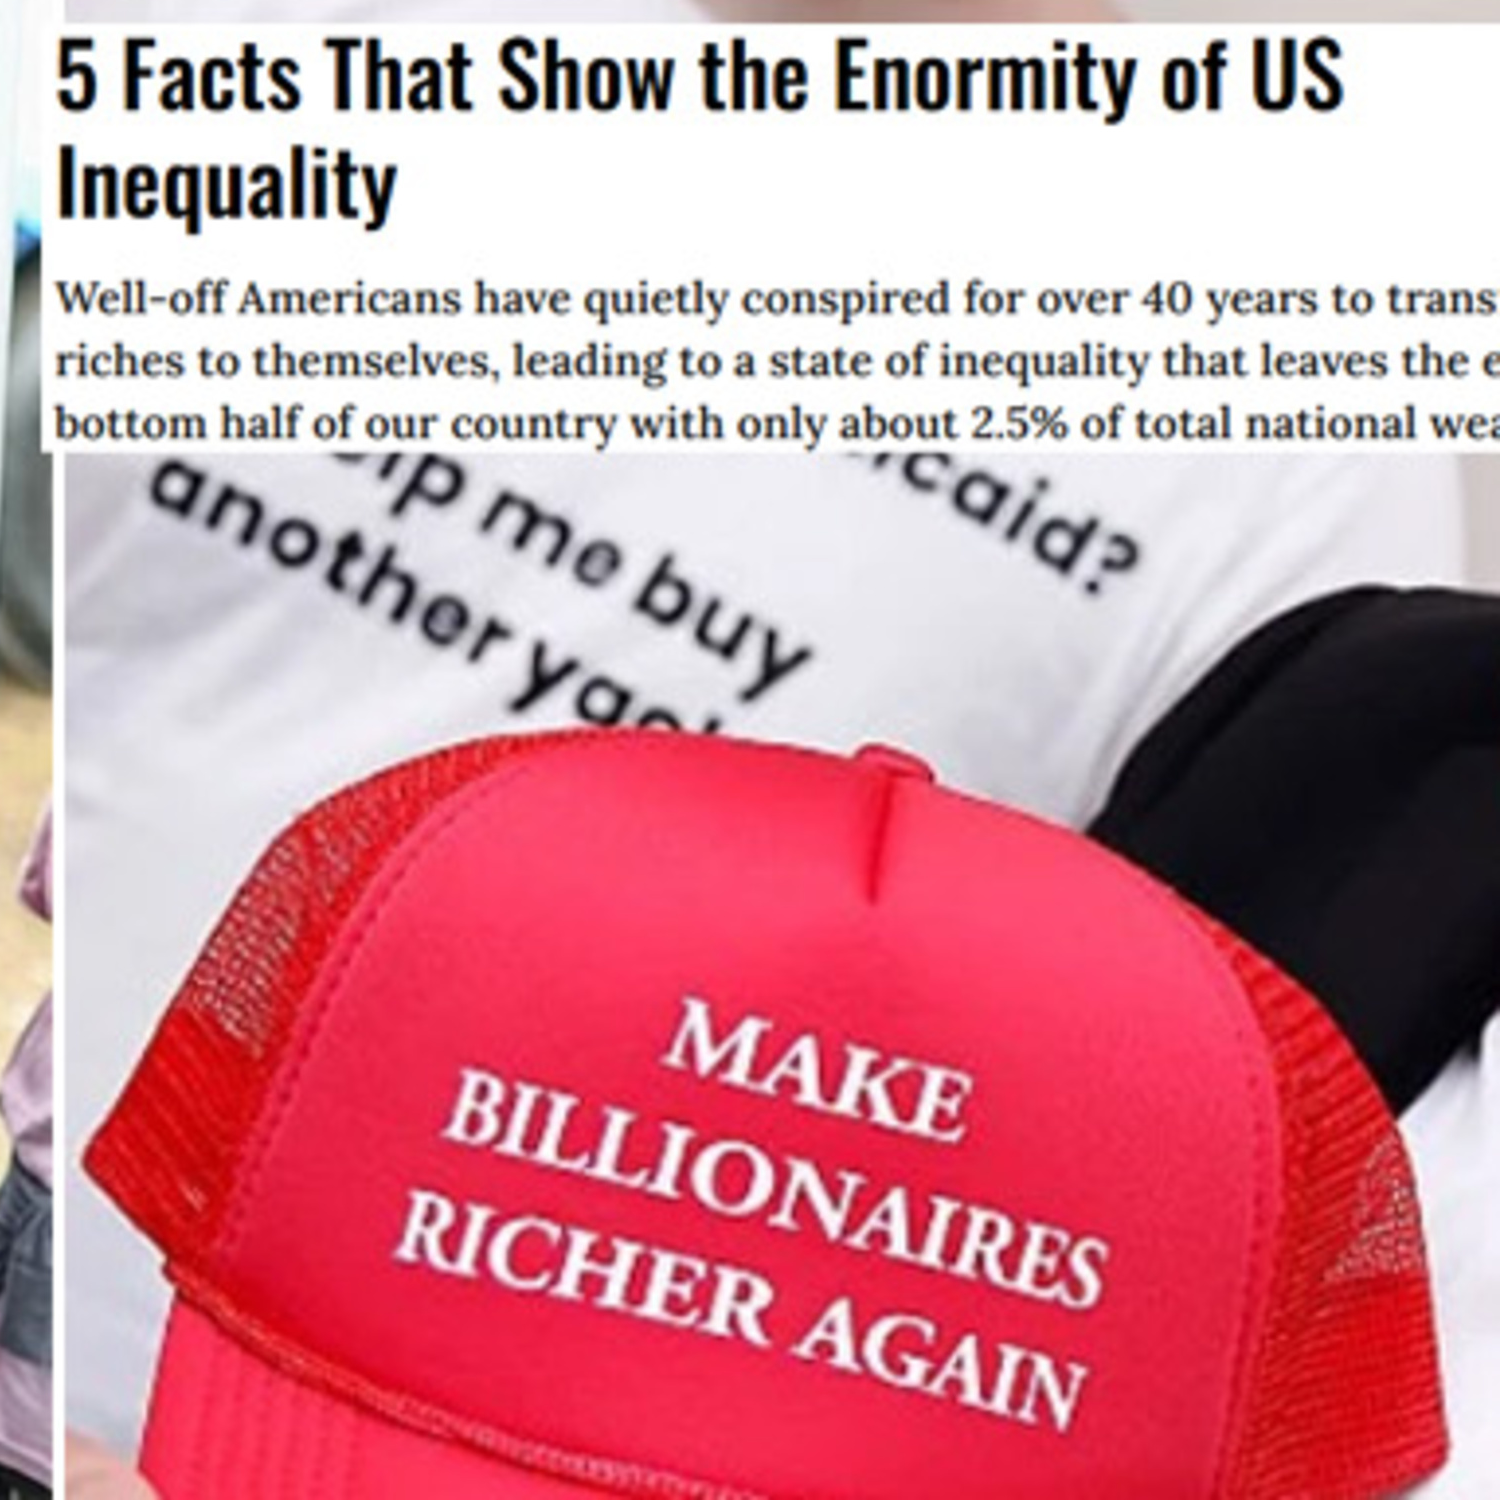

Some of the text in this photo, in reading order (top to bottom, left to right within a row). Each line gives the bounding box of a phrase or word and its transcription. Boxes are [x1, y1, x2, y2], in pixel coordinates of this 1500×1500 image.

[147, 457, 512, 664] another
[479, 489, 814, 704] me buy
[665, 998, 973, 1143] MAKE
[444, 1069, 1108, 1308] BILLIONAIRES
[395, 1190, 1088, 1430] RICHER AGAIN
